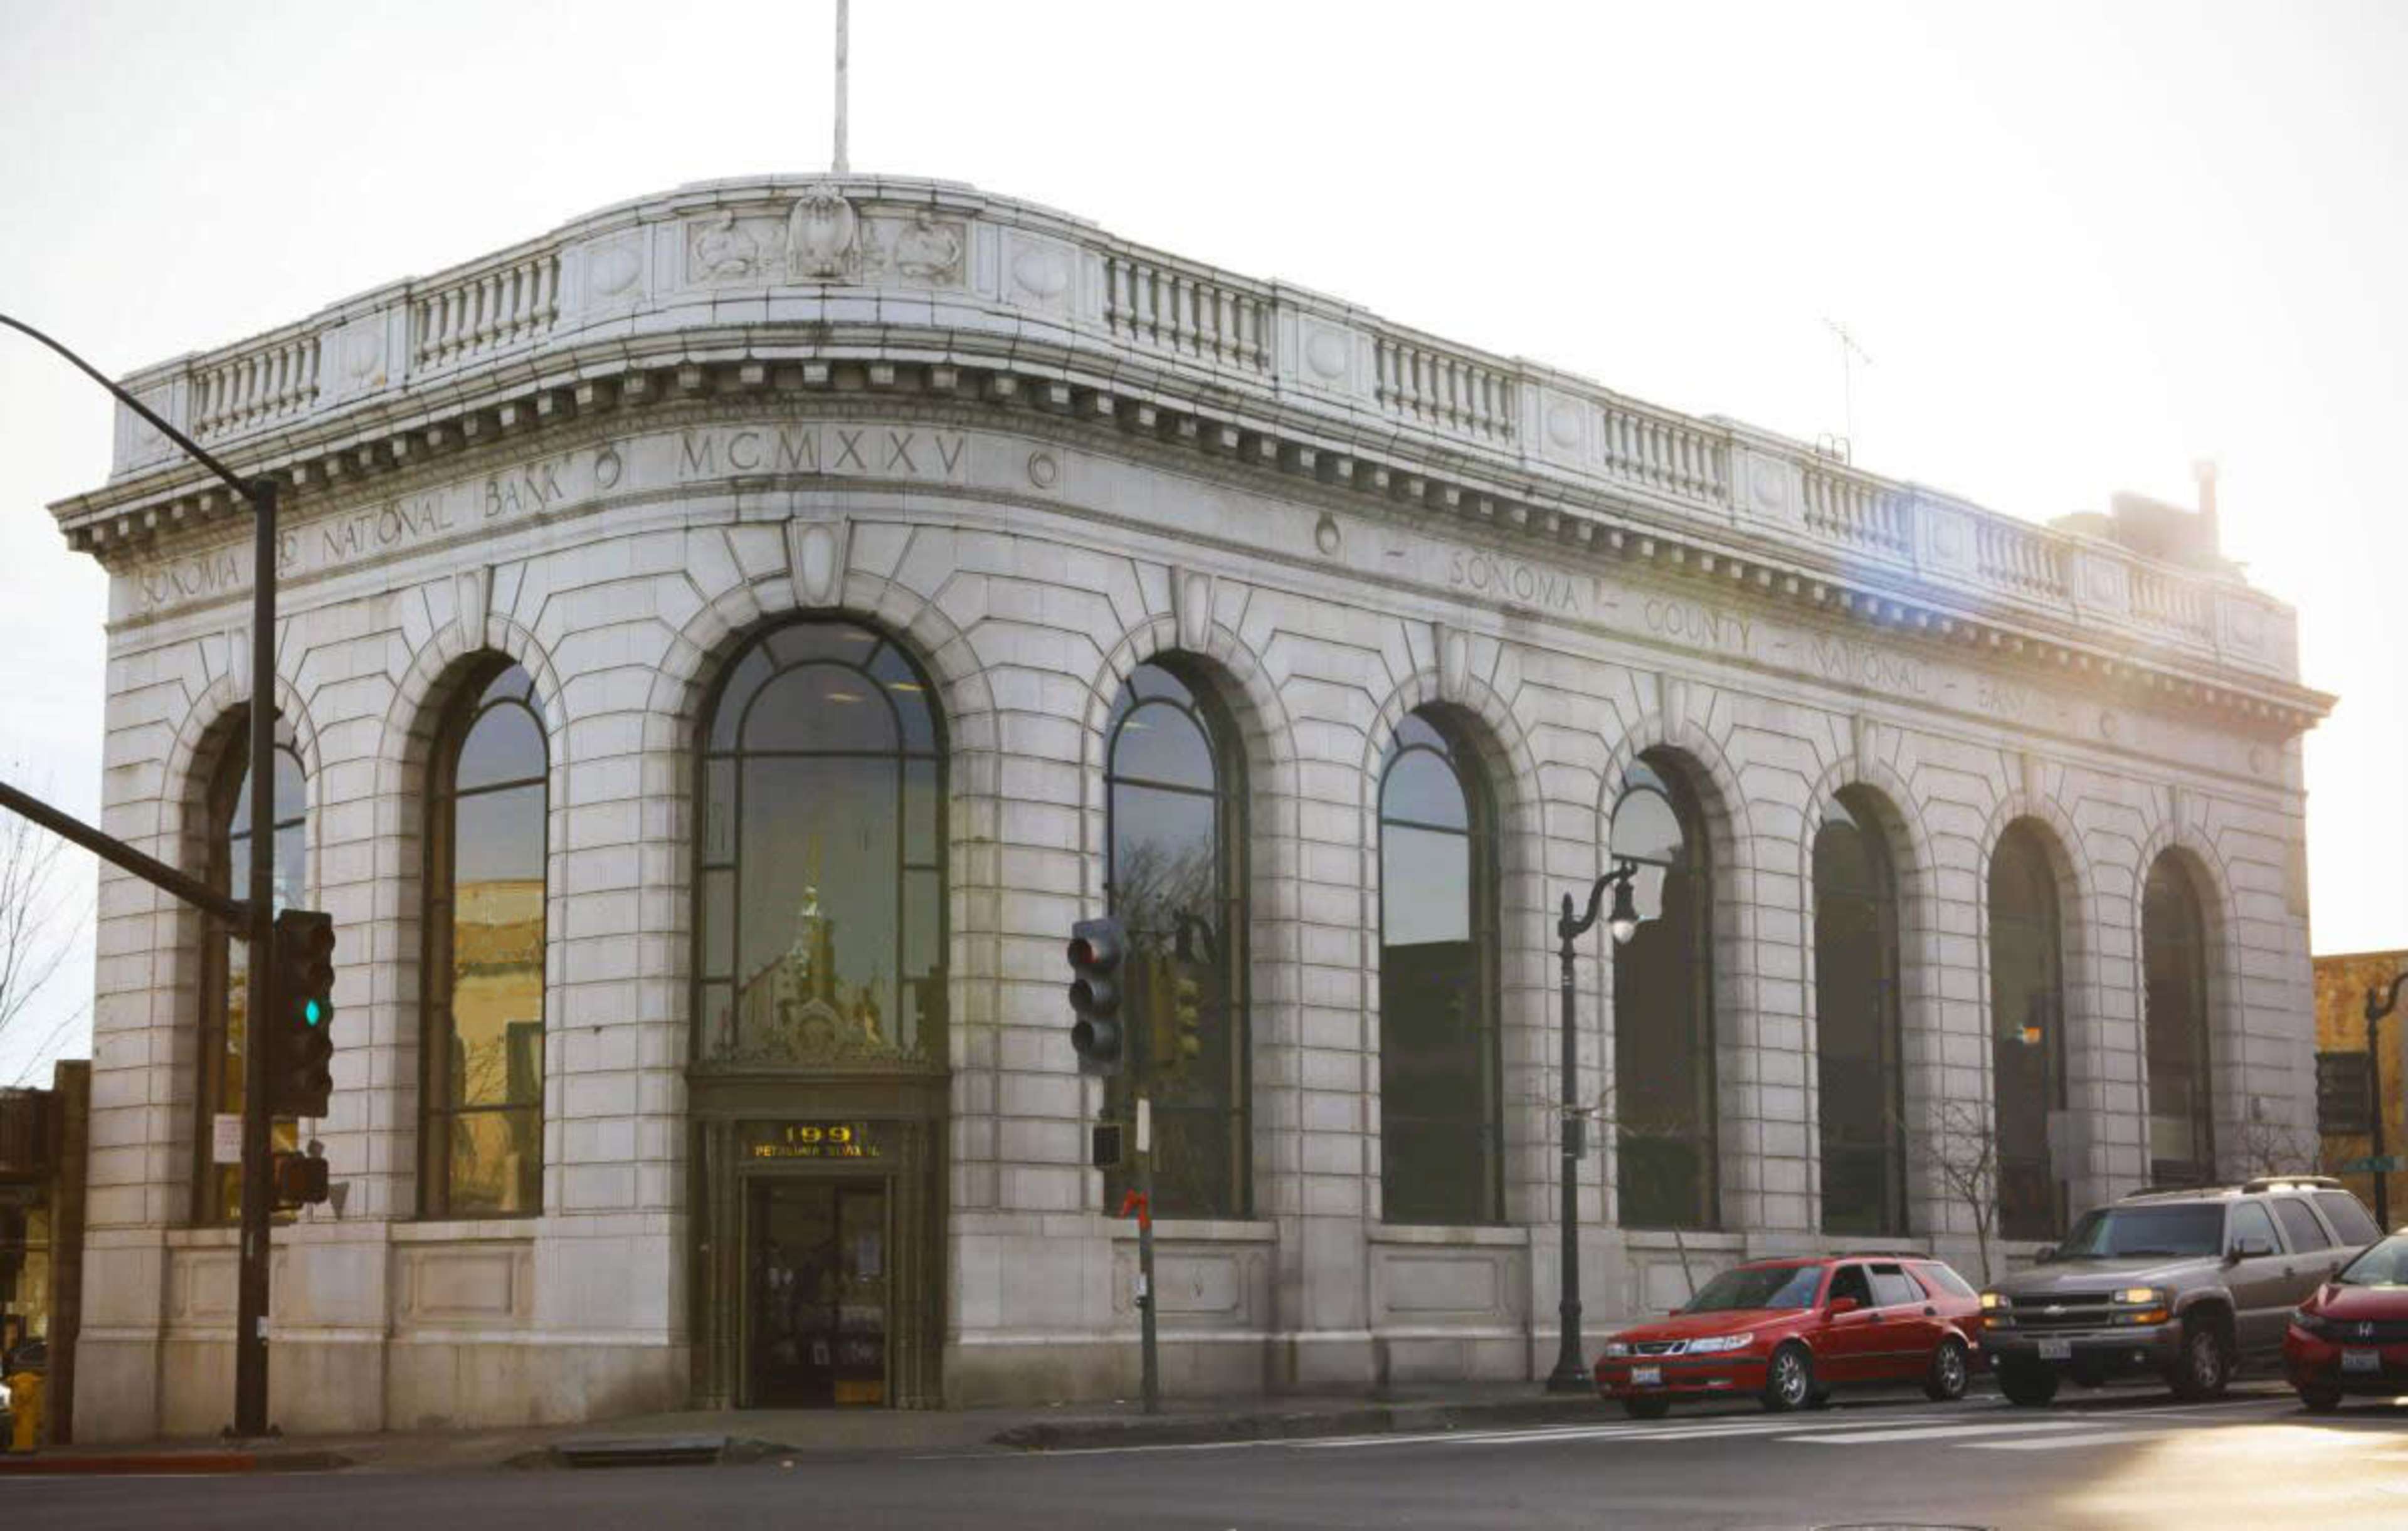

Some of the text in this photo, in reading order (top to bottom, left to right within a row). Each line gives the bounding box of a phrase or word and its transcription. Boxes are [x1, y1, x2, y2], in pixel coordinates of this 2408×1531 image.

[679, 431, 964, 476] MCMXXV
[322, 502, 453, 562] NATIONAL
[484, 462, 564, 518] BANK
[1449, 552, 1579, 613] SONOMA
[1644, 598, 1753, 651] COUNTY
